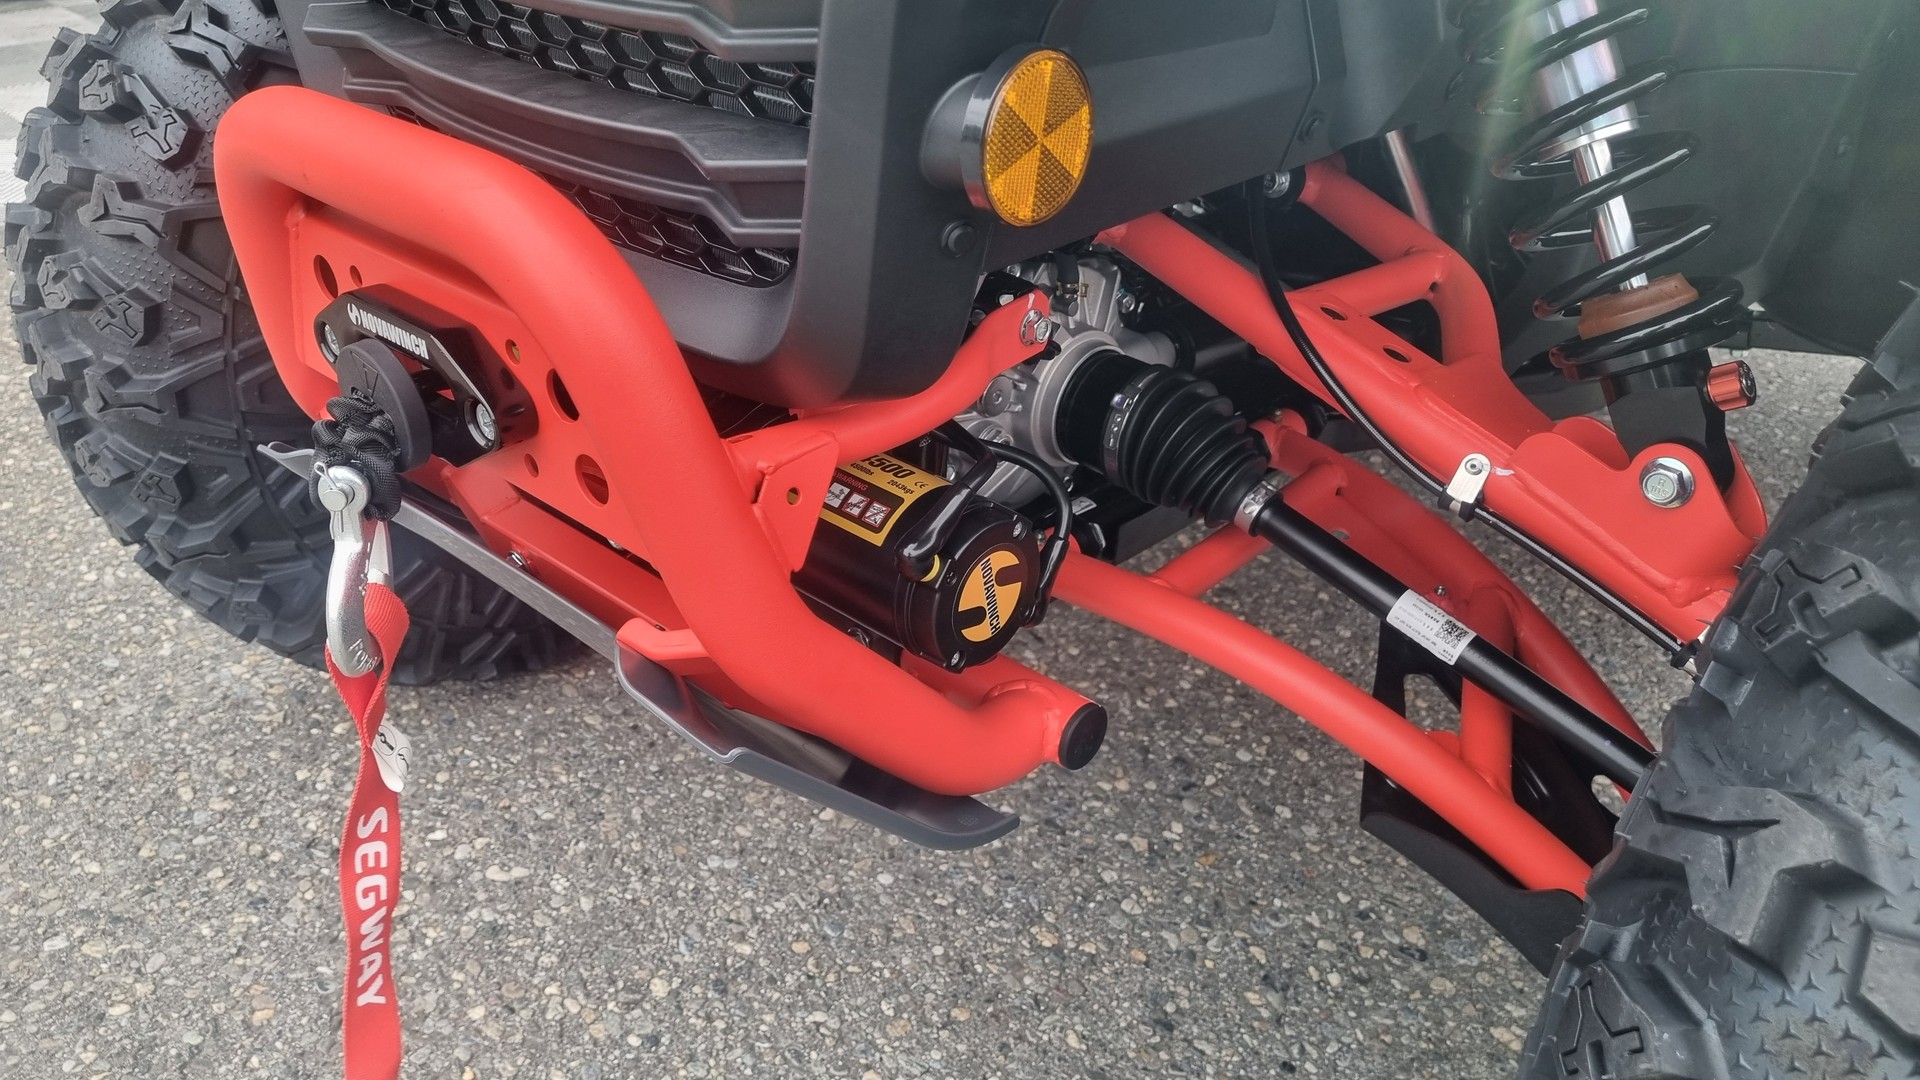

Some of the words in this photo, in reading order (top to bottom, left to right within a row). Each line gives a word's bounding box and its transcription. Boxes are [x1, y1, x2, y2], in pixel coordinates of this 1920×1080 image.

[359, 308, 430, 360] NOVAWINCH
[837, 472, 868, 491] WARNING
[886, 479, 915, 496] 2043kgs
[980, 557, 1002, 635] NOVAWINCH
[353, 806, 389, 1007] SEGWAY
